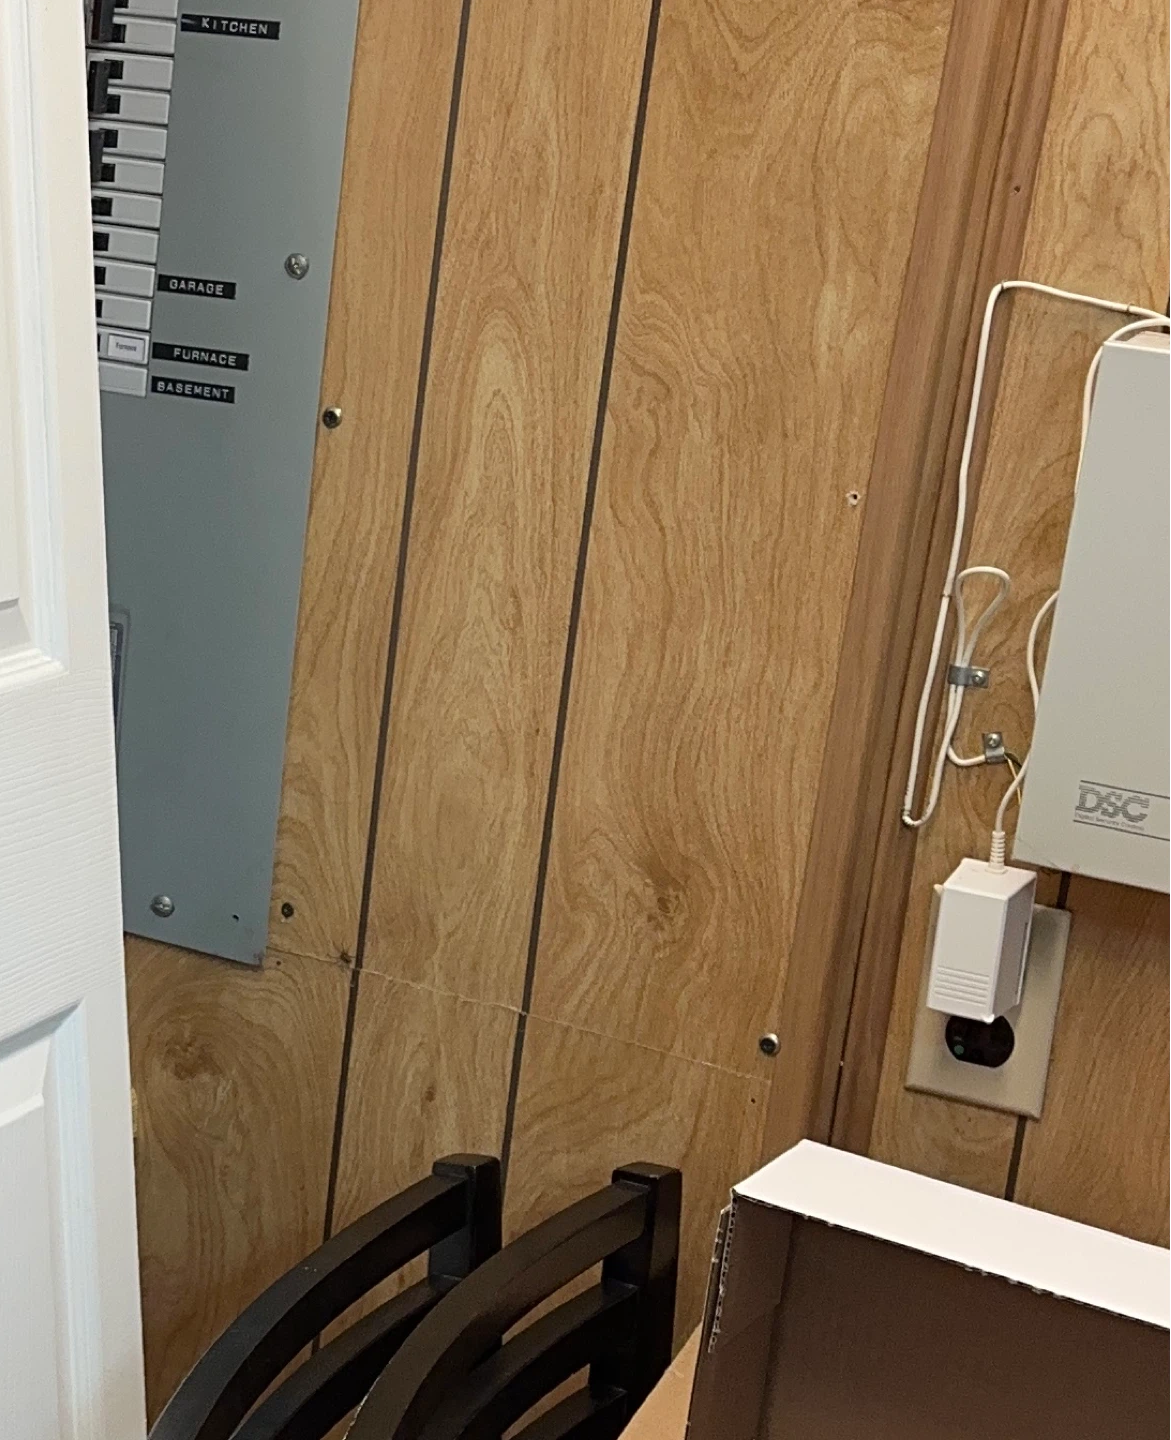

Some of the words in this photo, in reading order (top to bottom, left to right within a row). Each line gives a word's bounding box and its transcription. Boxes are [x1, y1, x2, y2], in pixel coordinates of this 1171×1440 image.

[201, 17, 269, 35] KITCHEN
[169, 279, 224, 296] GARAGE
[173, 348, 237, 366] FURNACE
[157, 381, 229, 399] BASEMENT
[1075, 785, 1150, 823] DSC
